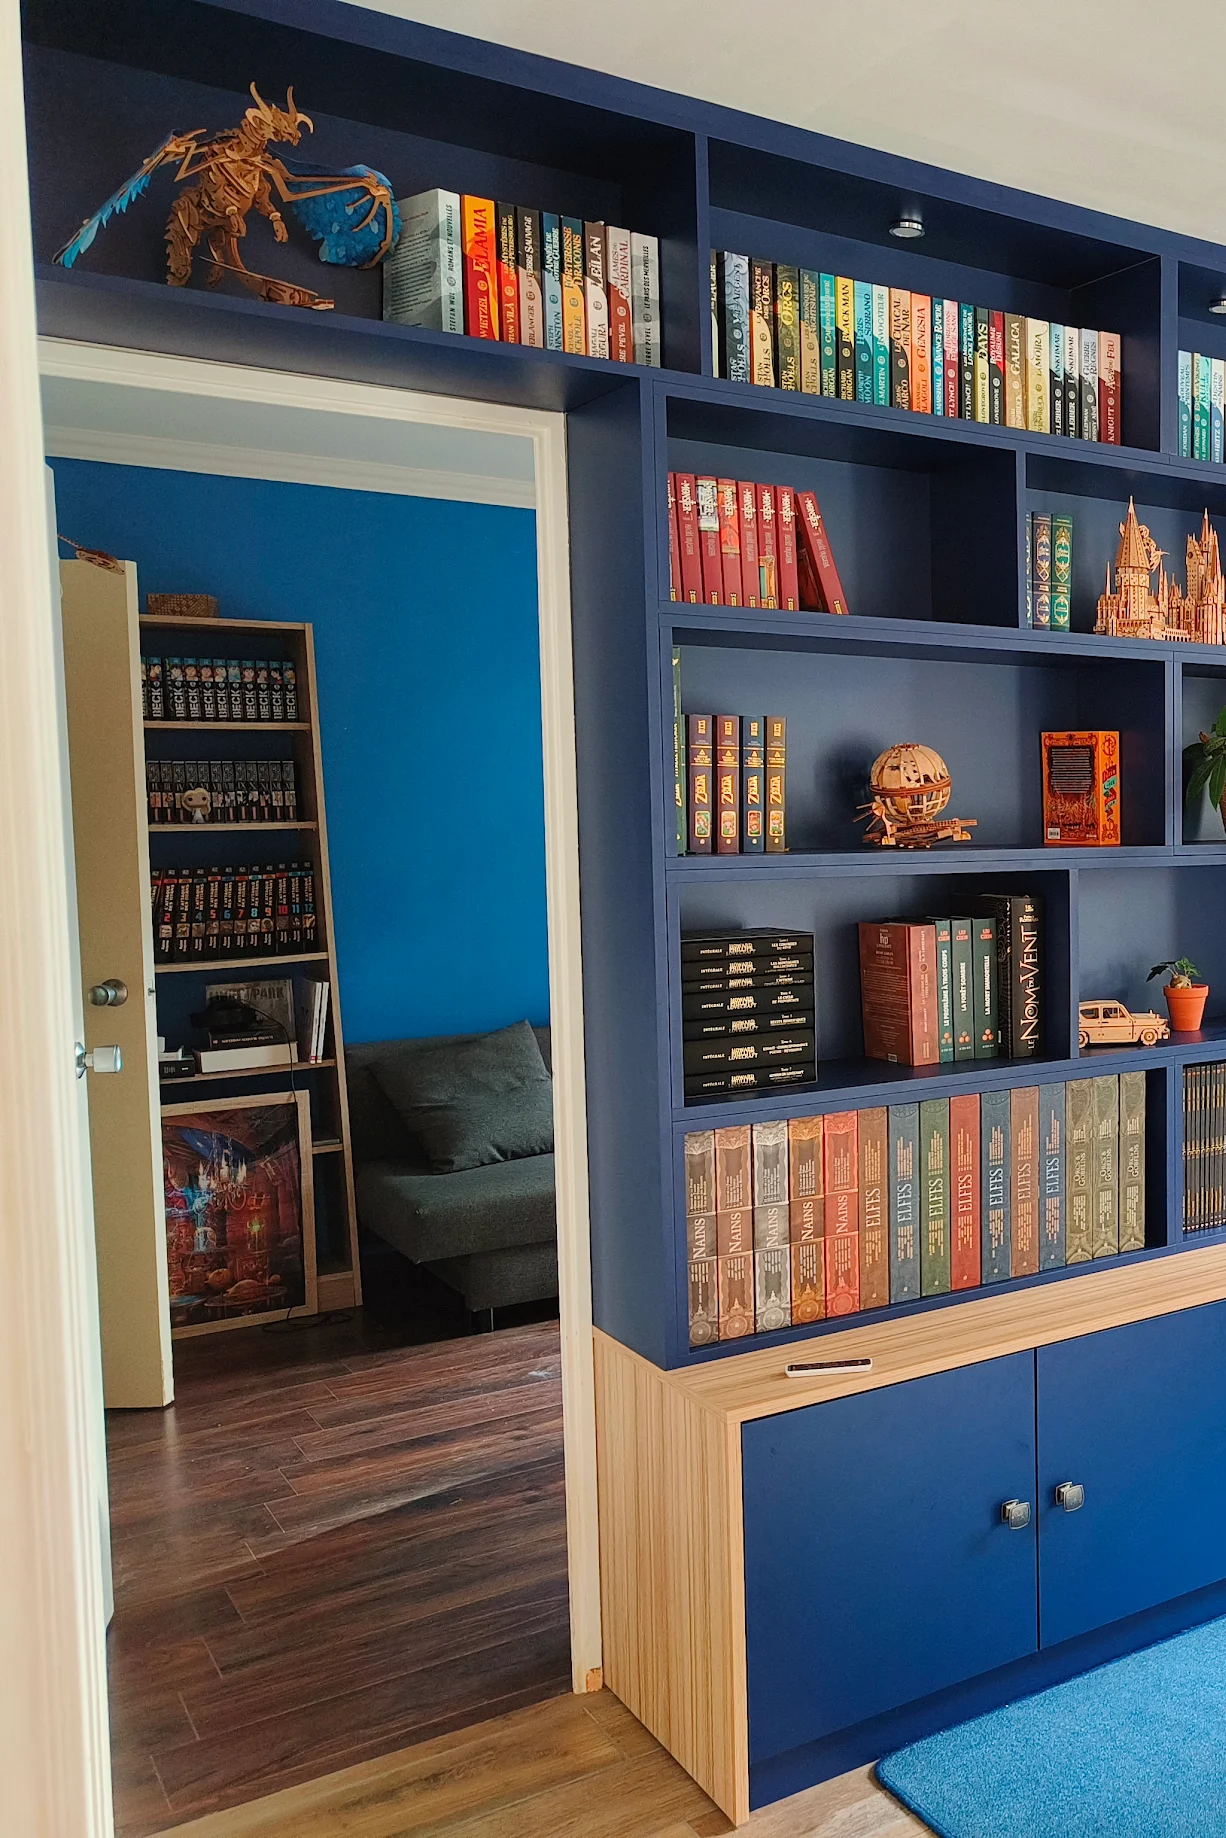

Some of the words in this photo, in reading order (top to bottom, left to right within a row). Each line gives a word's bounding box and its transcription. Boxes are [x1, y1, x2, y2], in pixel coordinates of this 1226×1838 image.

[473, 209, 490, 272] ELAMIA
[524, 216, 533, 253] SAUVAGE
[546, 232, 551, 242] DE
[564, 227, 574, 288] FORTERESSE
[573, 234, 583, 286] DRACONIS
[588, 236, 603, 288] LEÏLAN
[619, 241, 629, 299] CARDINAL
[762, 276, 770, 304] ORCS
[781, 282, 794, 325] ORCS
[479, 297, 488, 337] WIETZEL
[505, 303, 514, 322] VILÀ
[893, 298, 901, 341] CHACAL
[901, 310, 910, 332] NAR
[904, 334, 909, 346] DE
[917, 308, 926, 358] GENESIA
[978, 323, 988, 360] DAYS
[1011, 323, 1020, 375] GALLICA
[1107, 340, 1115, 358] FEU
[151, 688, 161, 718] BECK
[174, 688, 185, 717] BECK
[188, 689, 199, 717] BECK
[203, 689, 214, 718] BECK
[217, 689, 227, 718] BECK
[231, 690, 241, 718] BECK
[245, 690, 256, 718] BECK
[259, 691, 269, 718] BECK
[272, 692, 282, 718] BECK
[286, 691, 296, 718] BECK
[695, 774, 708, 804] ZELDA
[721, 774, 734, 805] ZELDA
[748, 775, 759, 805] ZELDA
[770, 775, 782, 805] ZELDA
[164, 913, 170, 922] 2
[181, 913, 186, 922] 3
[196, 912, 202, 920] 4
[210, 910, 216, 918] 5
[224, 910, 230, 918] 6
[239, 909, 244, 918] 7
[251, 908, 257, 917] 8
[265, 908, 271, 916] 9
[278, 905, 288, 915] 10
[292, 905, 299, 913] 11
[305, 904, 313, 912] 12
[1020, 925, 1039, 983] VENT
[253, 986, 284, 999] PARK
[1027, 977, 1034, 987] DU
[1021, 987, 1039, 1041] NOM
[1028, 1040, 1034, 1048] LE
[1018, 1163, 1031, 1199] ELFES
[1046, 1158, 1059, 1193] ELFES
[1099, 1157, 1107, 1177] ORCS
[928, 1178, 944, 1217] ELFES
[958, 1174, 972, 1212] ELFES
[990, 1168, 1004, 1206] ELFES
[837, 1195, 848, 1233] NAINS
[866, 1188, 880, 1227] ELFES
[898, 1183, 912, 1222] ELFES
[729, 1213, 742, 1253] NAINS
[766, 1208, 779, 1247] NAINS
[802, 1202, 814, 1240] NAINS
[693, 1219, 706, 1259] NAINS
